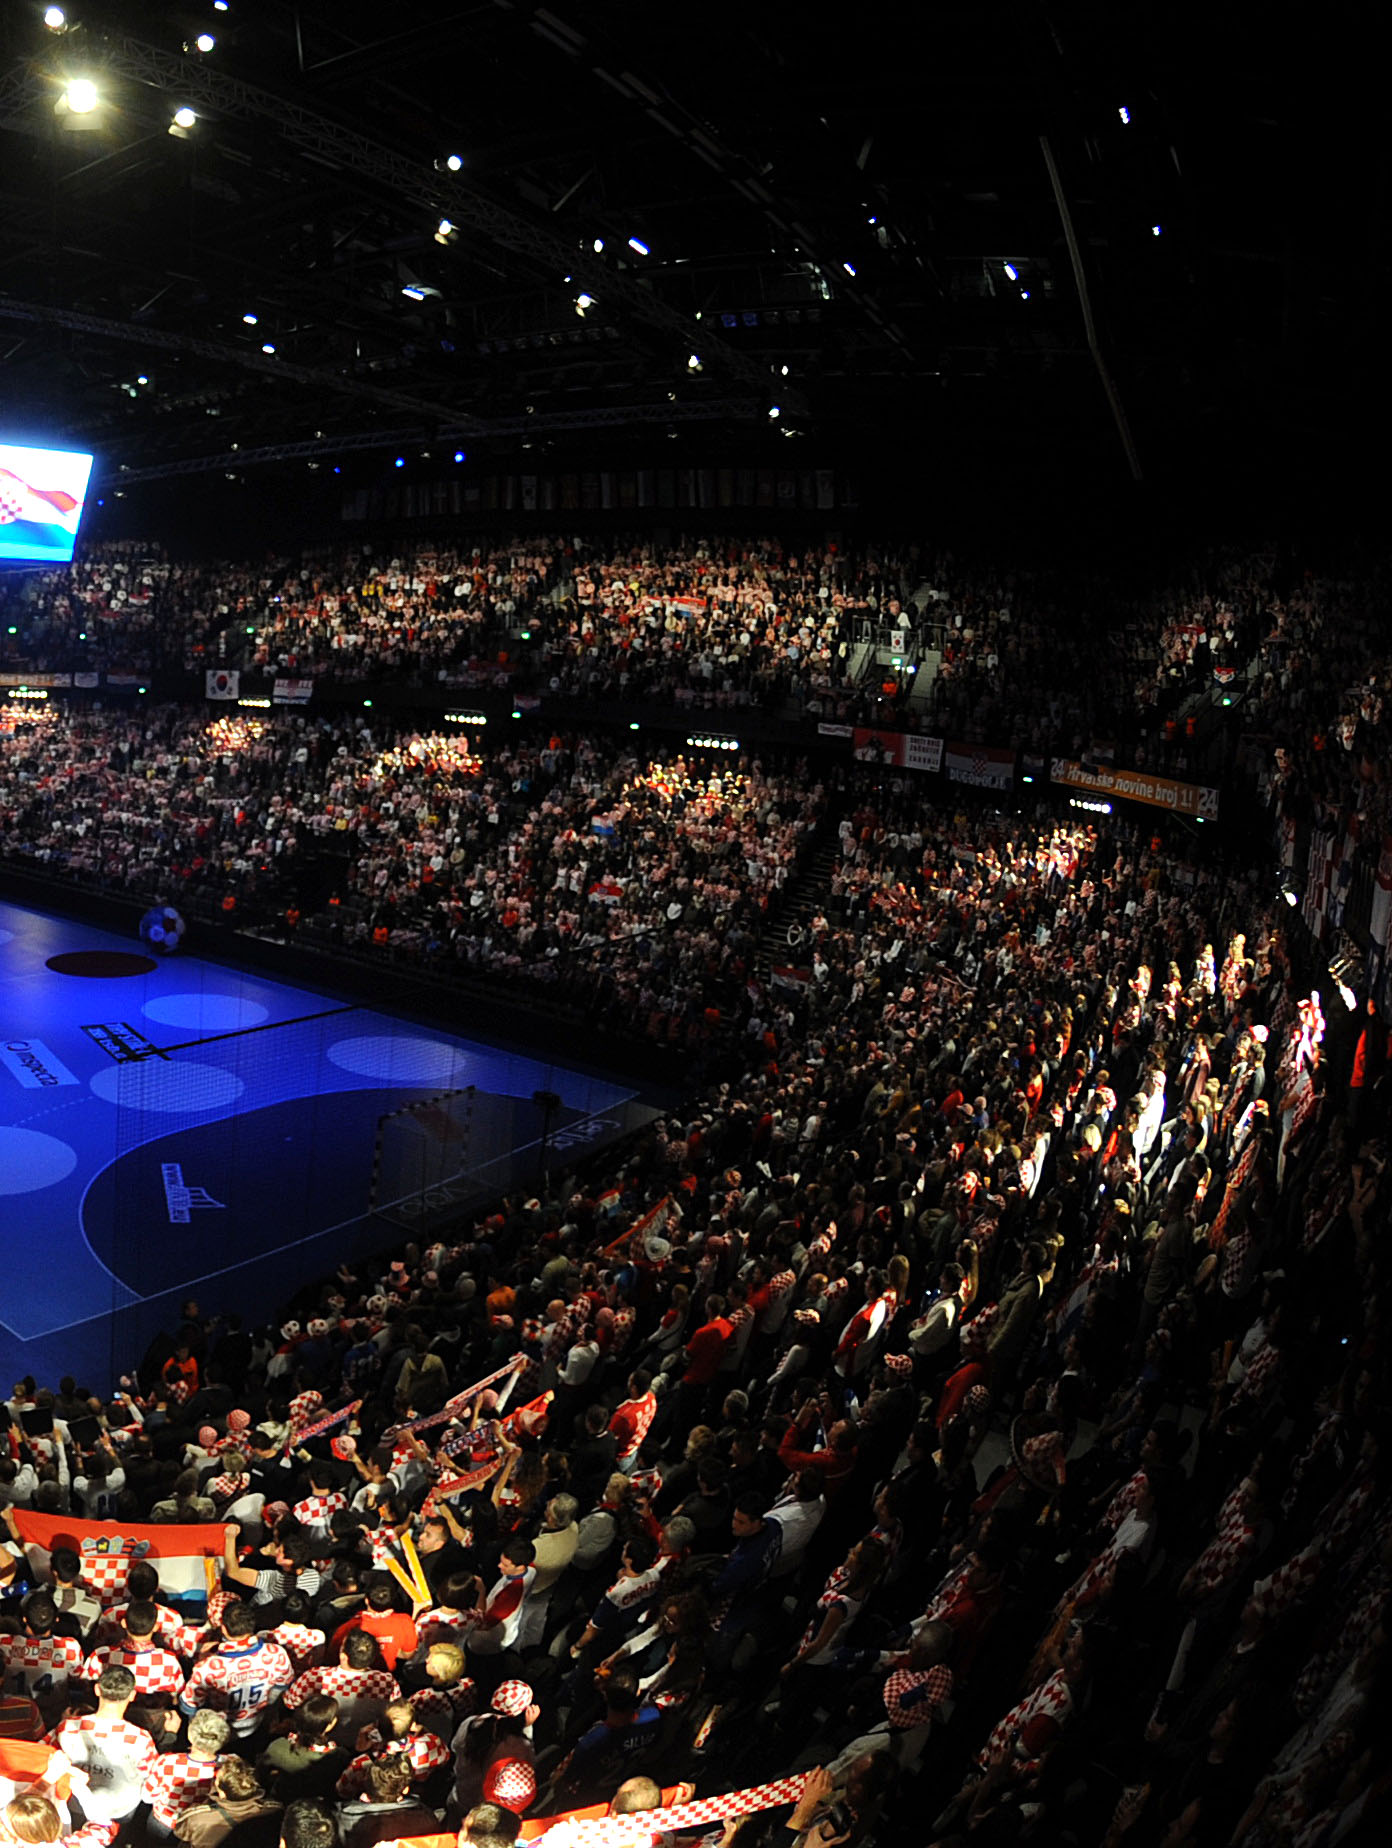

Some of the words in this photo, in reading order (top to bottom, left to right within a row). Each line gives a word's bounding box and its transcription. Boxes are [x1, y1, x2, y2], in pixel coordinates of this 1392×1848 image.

[1050, 757, 1065, 777] 24
[1114, 777, 1154, 799] novine
[1156, 783, 1179, 808] broj
[1181, 788, 1193, 808] 1!
[1199, 786, 1218, 810] 24
[12, 1671, 52, 1698] 14
